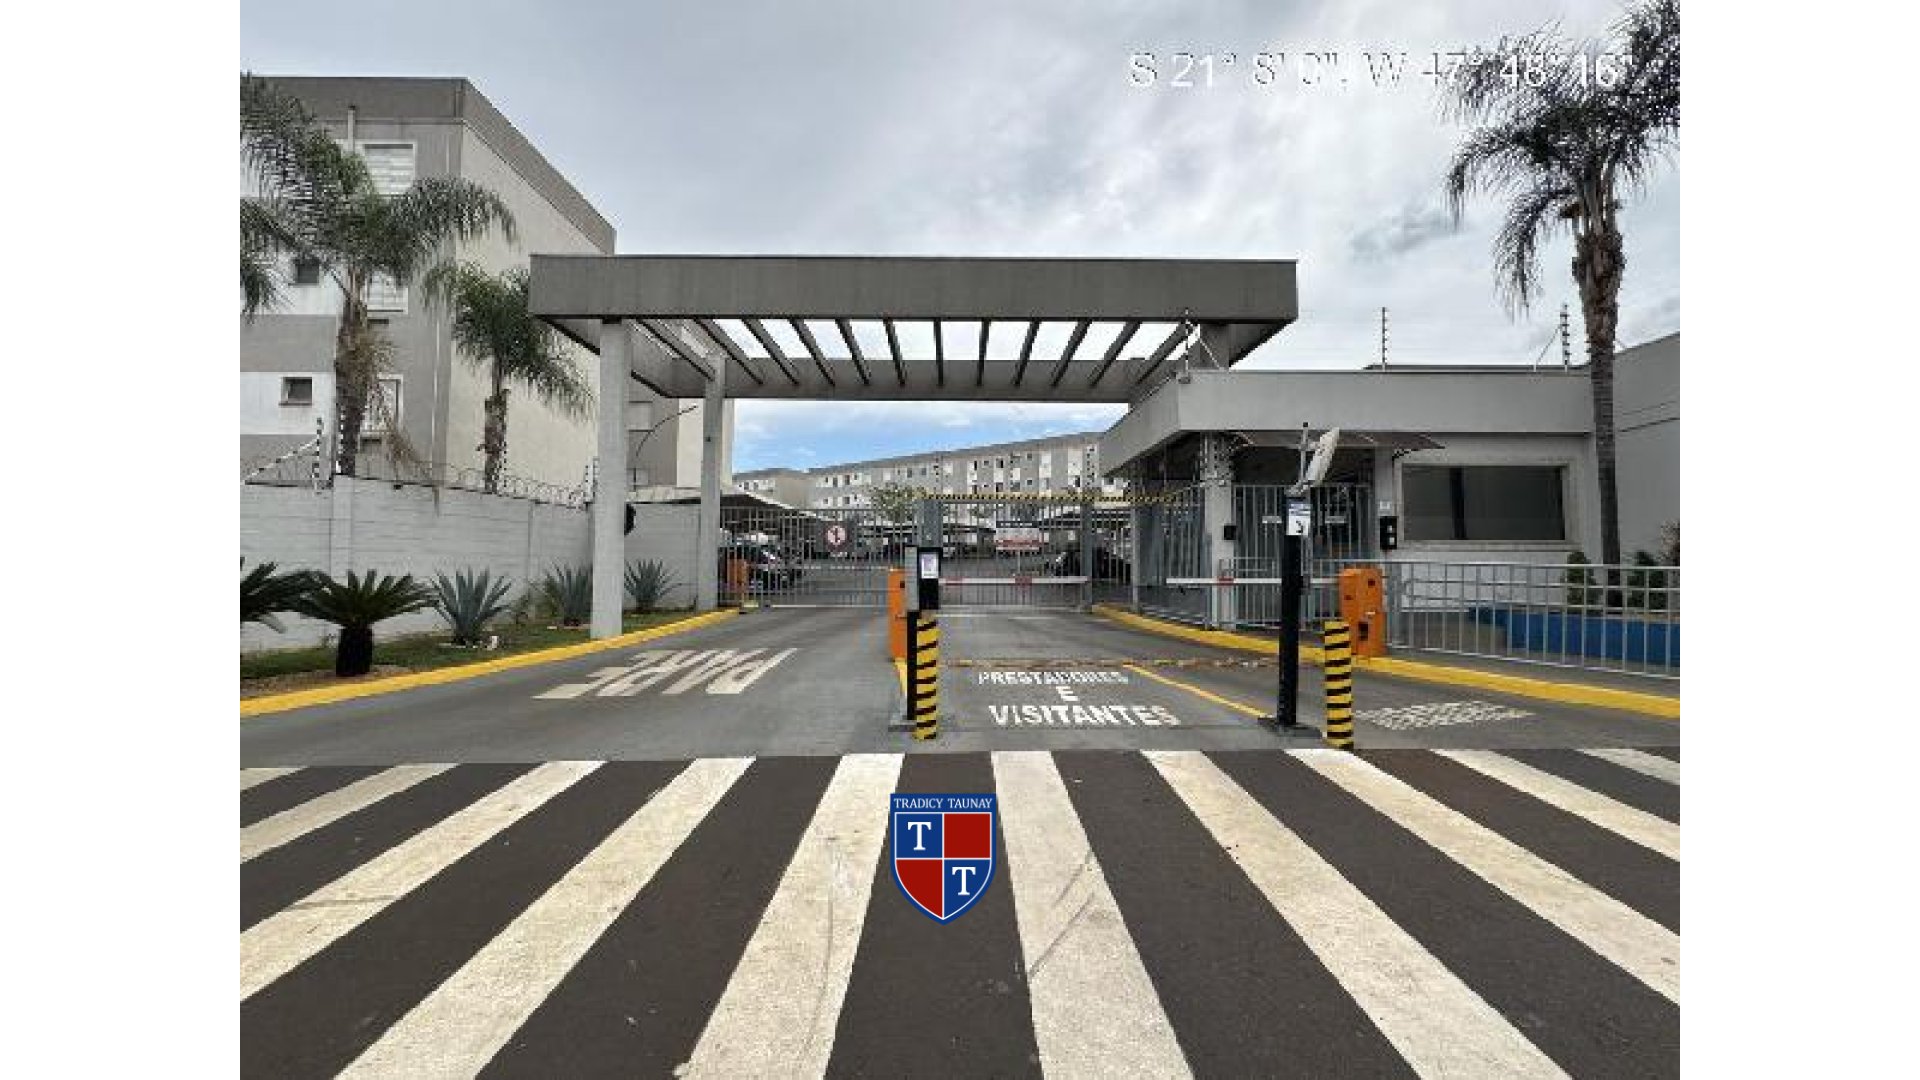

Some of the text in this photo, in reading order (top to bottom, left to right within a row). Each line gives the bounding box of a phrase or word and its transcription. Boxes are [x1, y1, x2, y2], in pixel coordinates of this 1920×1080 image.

[531, 647, 798, 699] PARE
[1055, 685, 1079, 701] E
[988, 704, 1181, 726] VISITANTES
